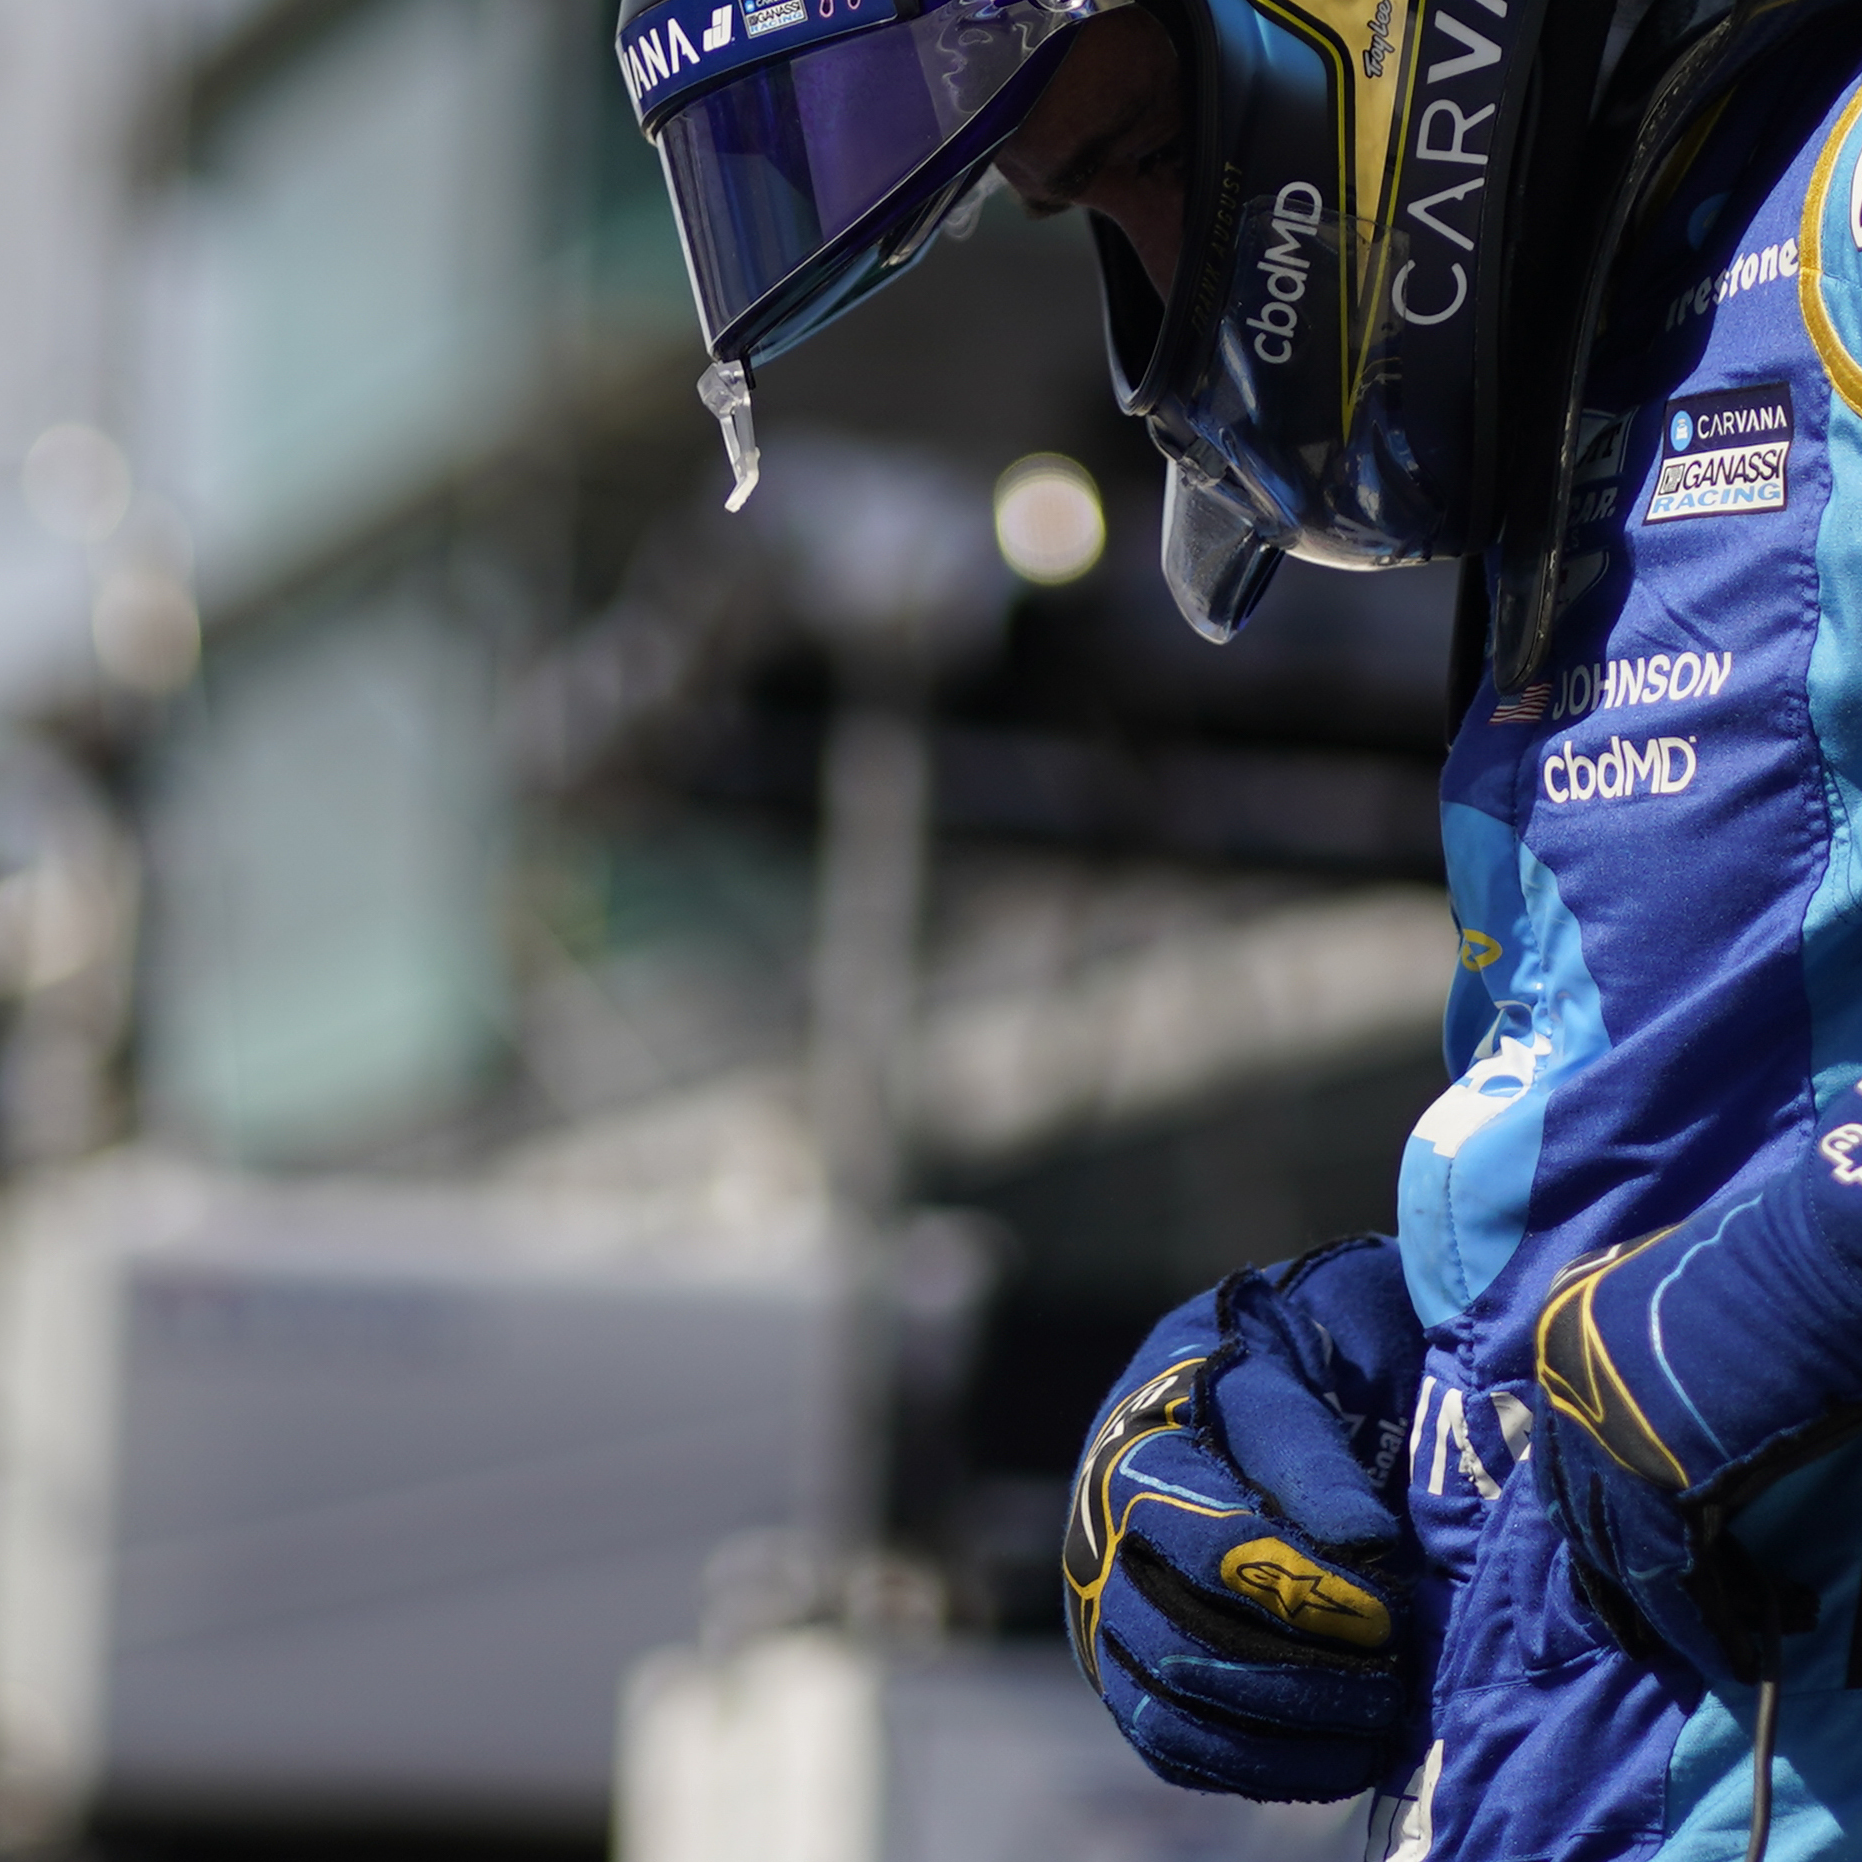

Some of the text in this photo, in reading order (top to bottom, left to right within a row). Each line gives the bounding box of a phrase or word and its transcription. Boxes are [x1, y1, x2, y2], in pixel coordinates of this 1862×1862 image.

[750, 11, 803, 33] RACING
[1367, 0, 1393, 38] Lee
[1363, 35, 1395, 79] Troy
[1245, 180, 1325, 364] cbdMD
[1665, 237, 1799, 332] irestone
[1697, 405, 1788, 439] CARVANA
[1683, 448, 1784, 491] GANASSI
[1651, 482, 1781, 514] RACING
[1551, 651, 1732, 720] JOHNSON
[1543, 736, 1698, 804] cbdMD
